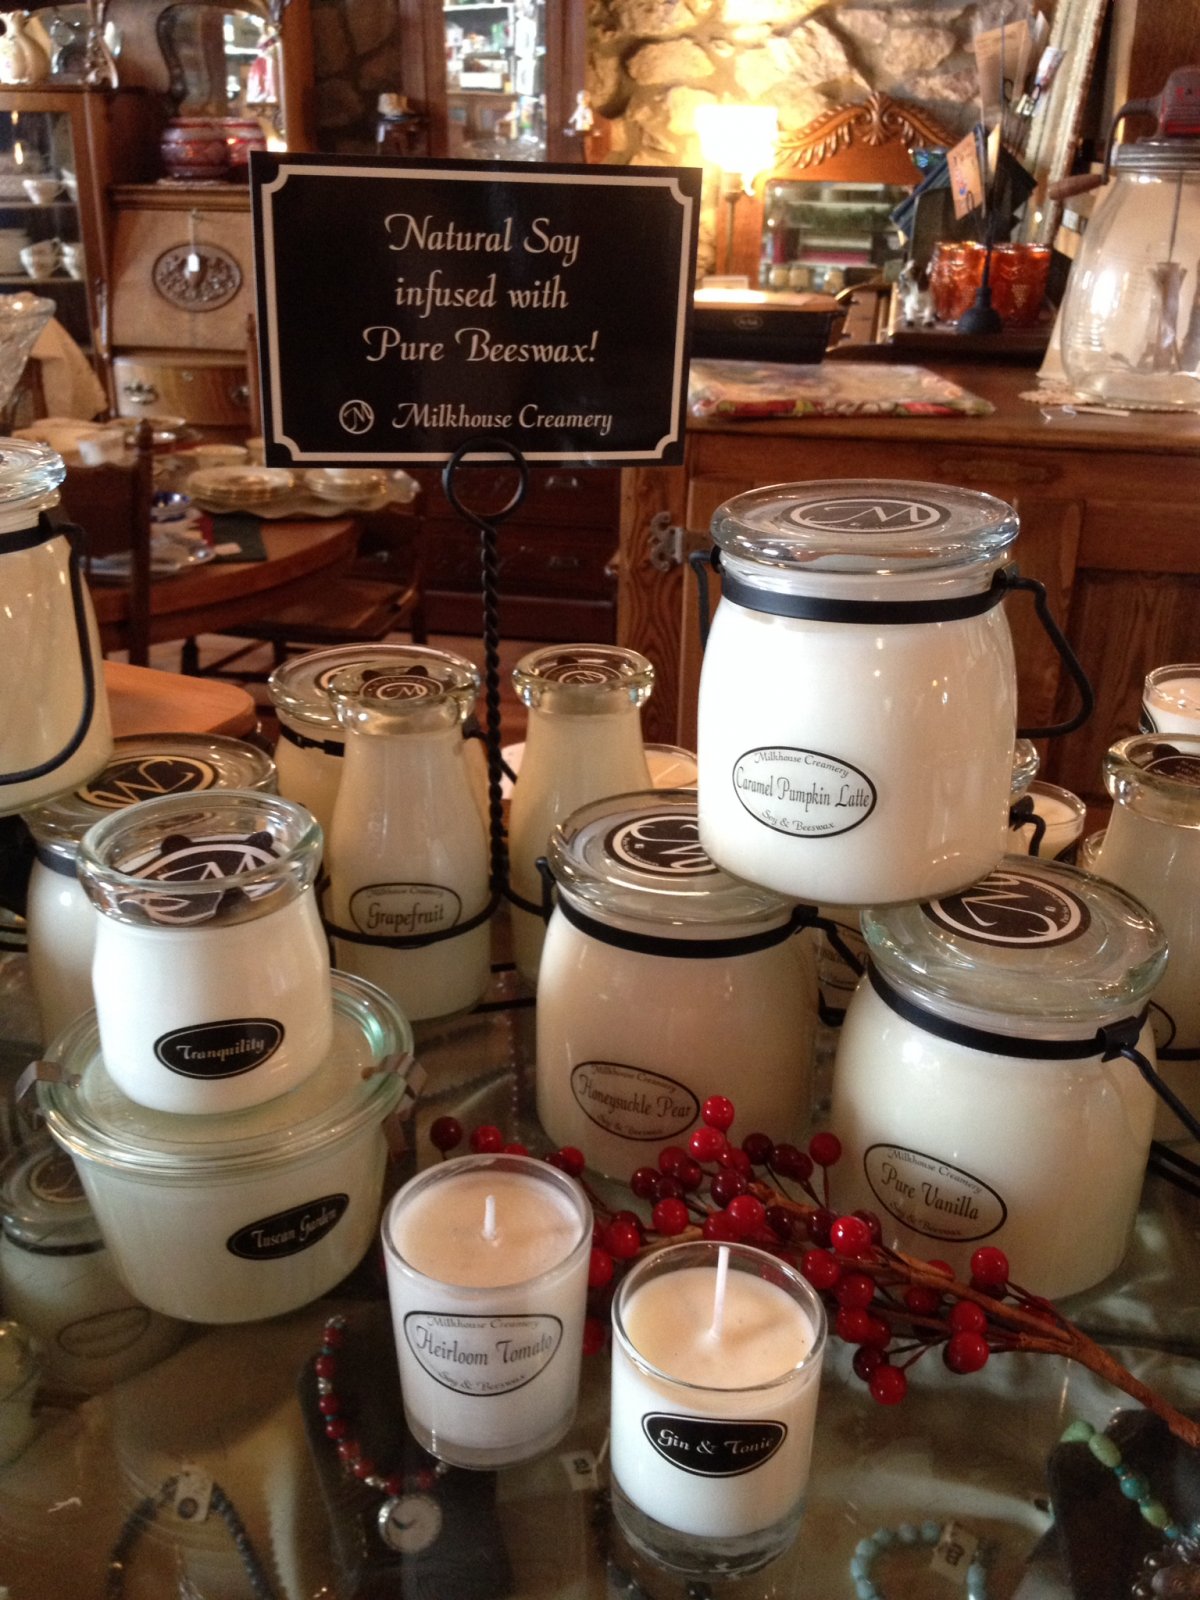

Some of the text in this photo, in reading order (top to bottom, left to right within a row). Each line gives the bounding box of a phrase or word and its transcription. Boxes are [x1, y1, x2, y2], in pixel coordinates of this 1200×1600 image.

[384, 213, 580, 267] Natural Soy
[395, 269, 569, 319] infused with
[362, 325, 599, 363] Pure Beeswax!
[392, 403, 613, 436] Milkhouse Creamery
[754, 751, 850, 778] Milkhouse Creamery
[736, 766, 870, 812] Caramel Pumpkin Latte
[792, 820, 835, 832] Beeswax
[367, 902, 444, 933] Grapefruit
[176, 1038, 265, 1062] Tranquility
[657, 1096, 691, 1118] Pear
[881, 1162, 915, 1199] Pure
[921, 1182, 979, 1220] Vanilla
[416, 1325, 552, 1365] Heirloom Tomato
[657, 1429, 774, 1455] Gin & Tonic
